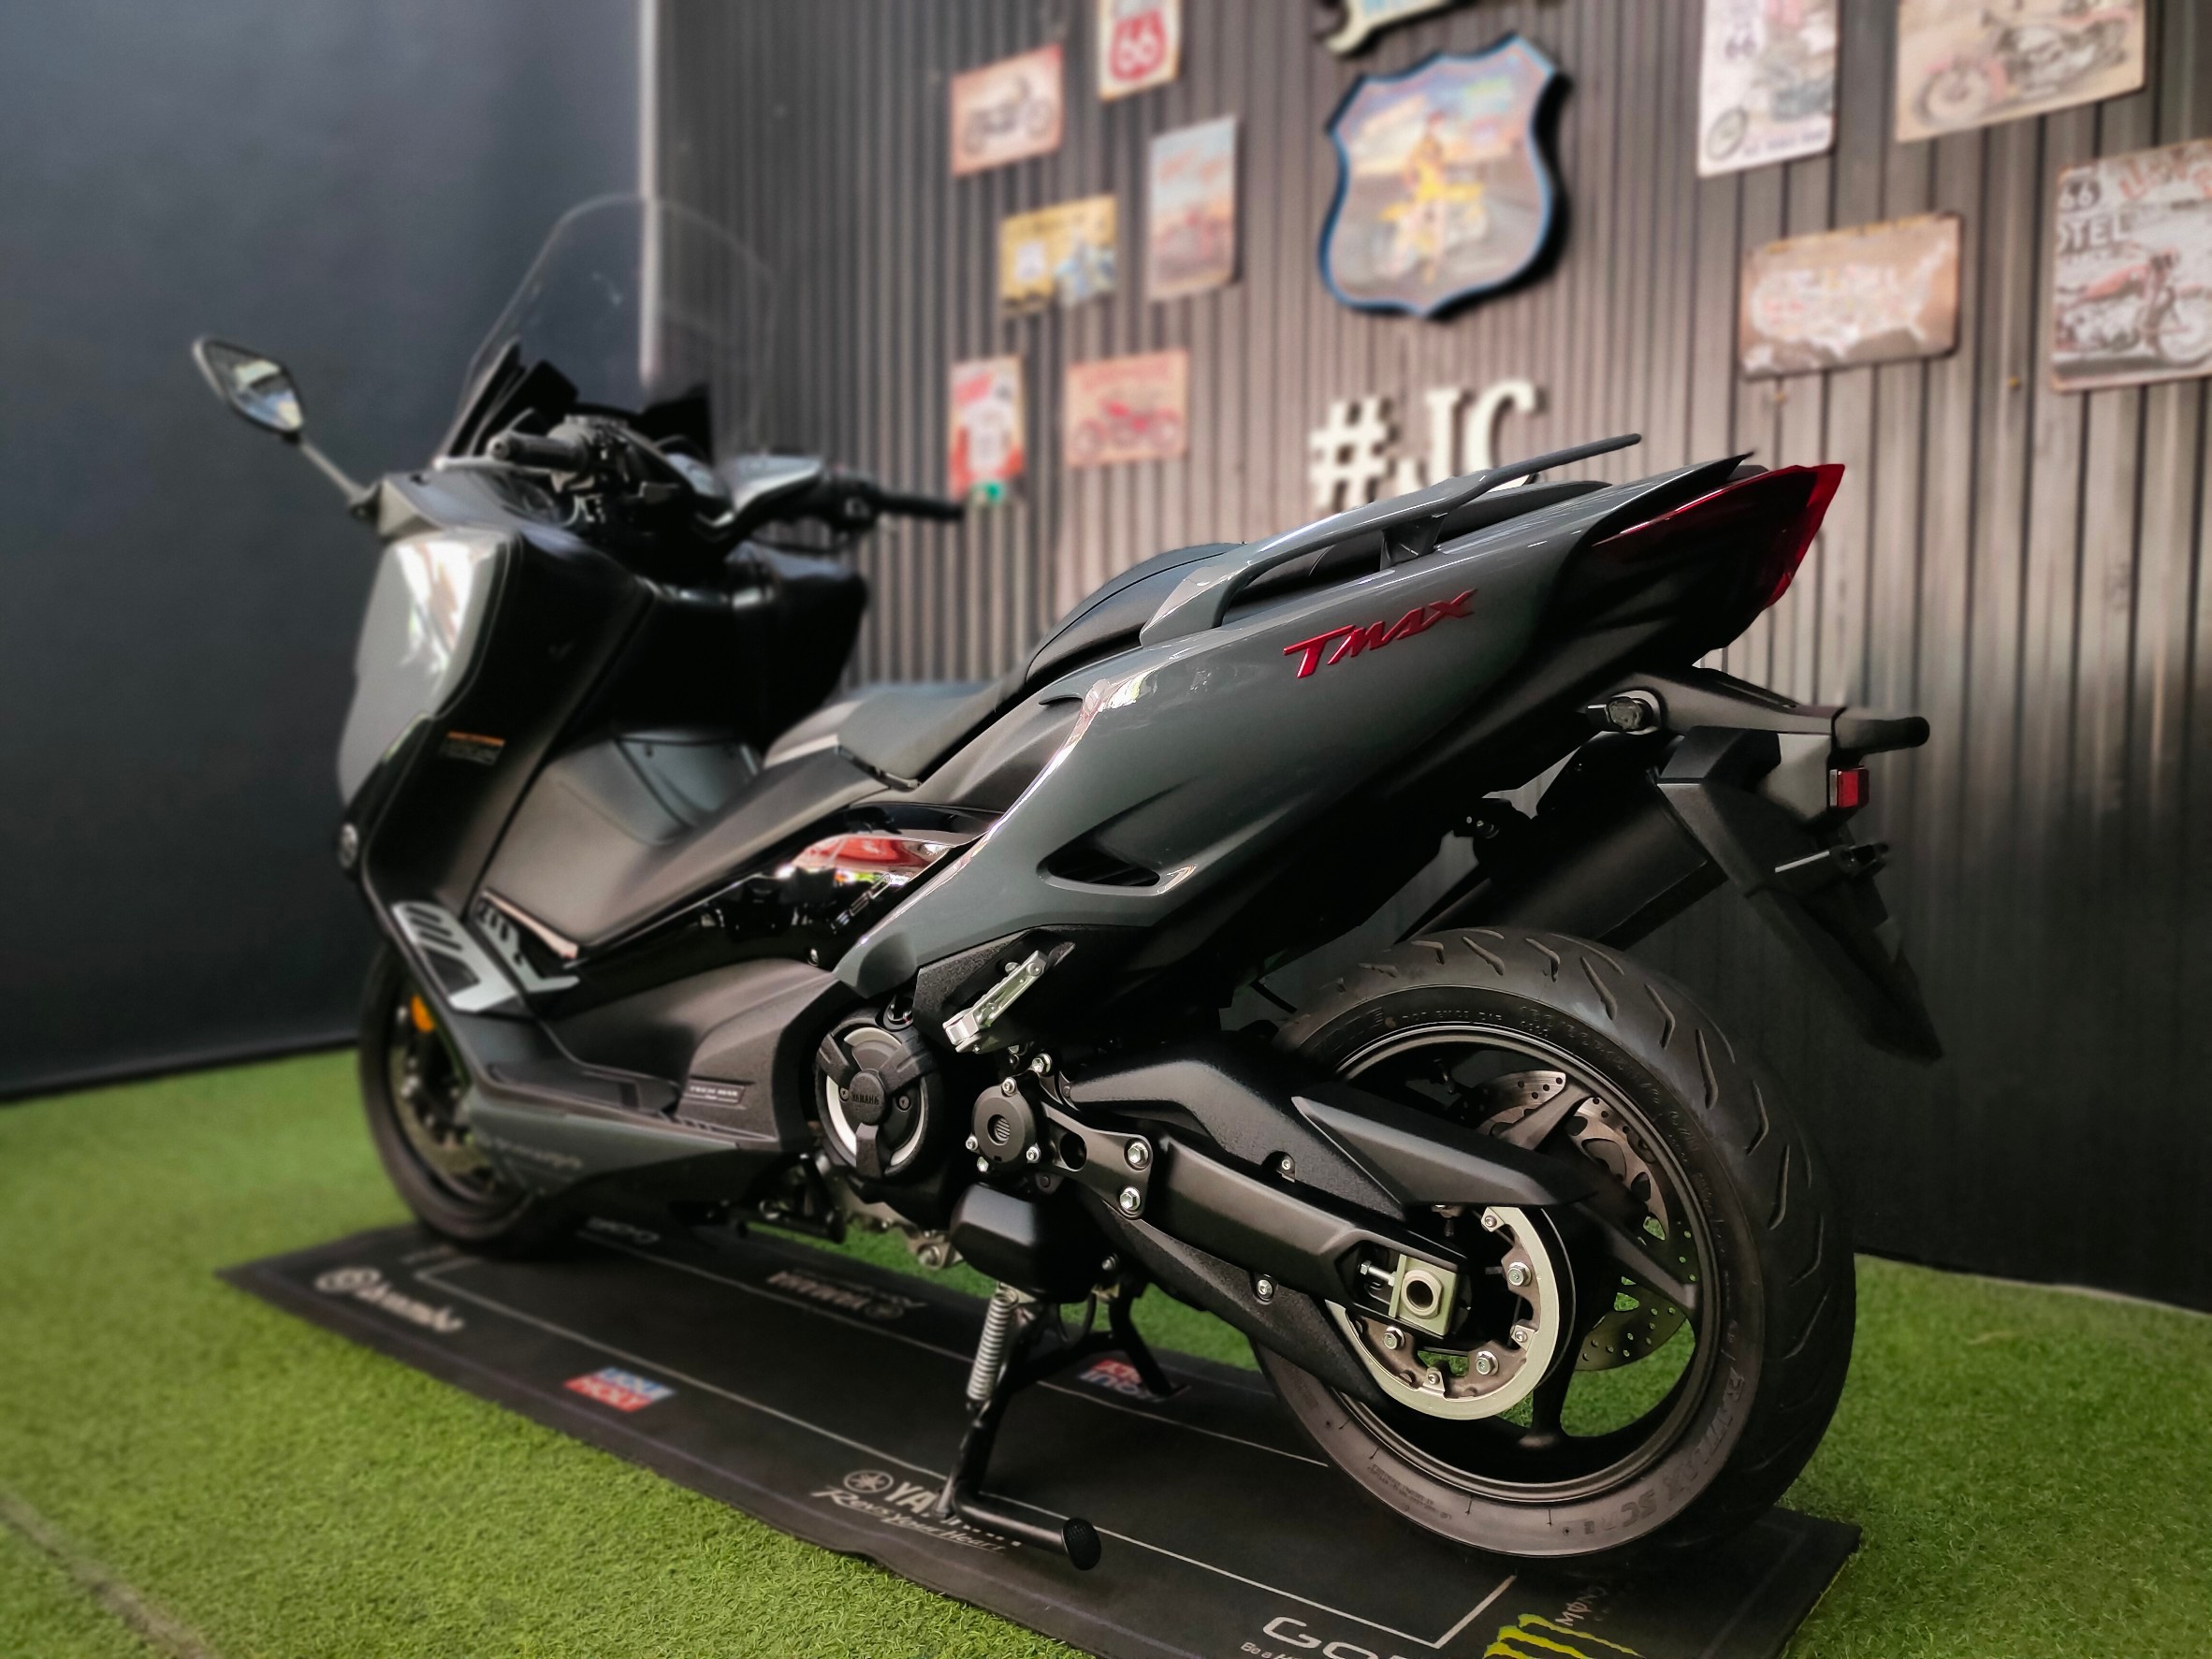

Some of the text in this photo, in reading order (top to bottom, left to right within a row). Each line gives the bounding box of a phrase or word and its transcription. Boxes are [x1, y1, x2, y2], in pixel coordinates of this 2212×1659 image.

[1117, 28, 1159, 73] 66
[1309, 380, 1536, 513] #JC
[1283, 589, 1477, 678] TMAX
[852, 1093, 880, 1105] YAMAHA
[1240, 1640, 1261, 1655] Be
[1262, 1620, 1409, 1659] GO
